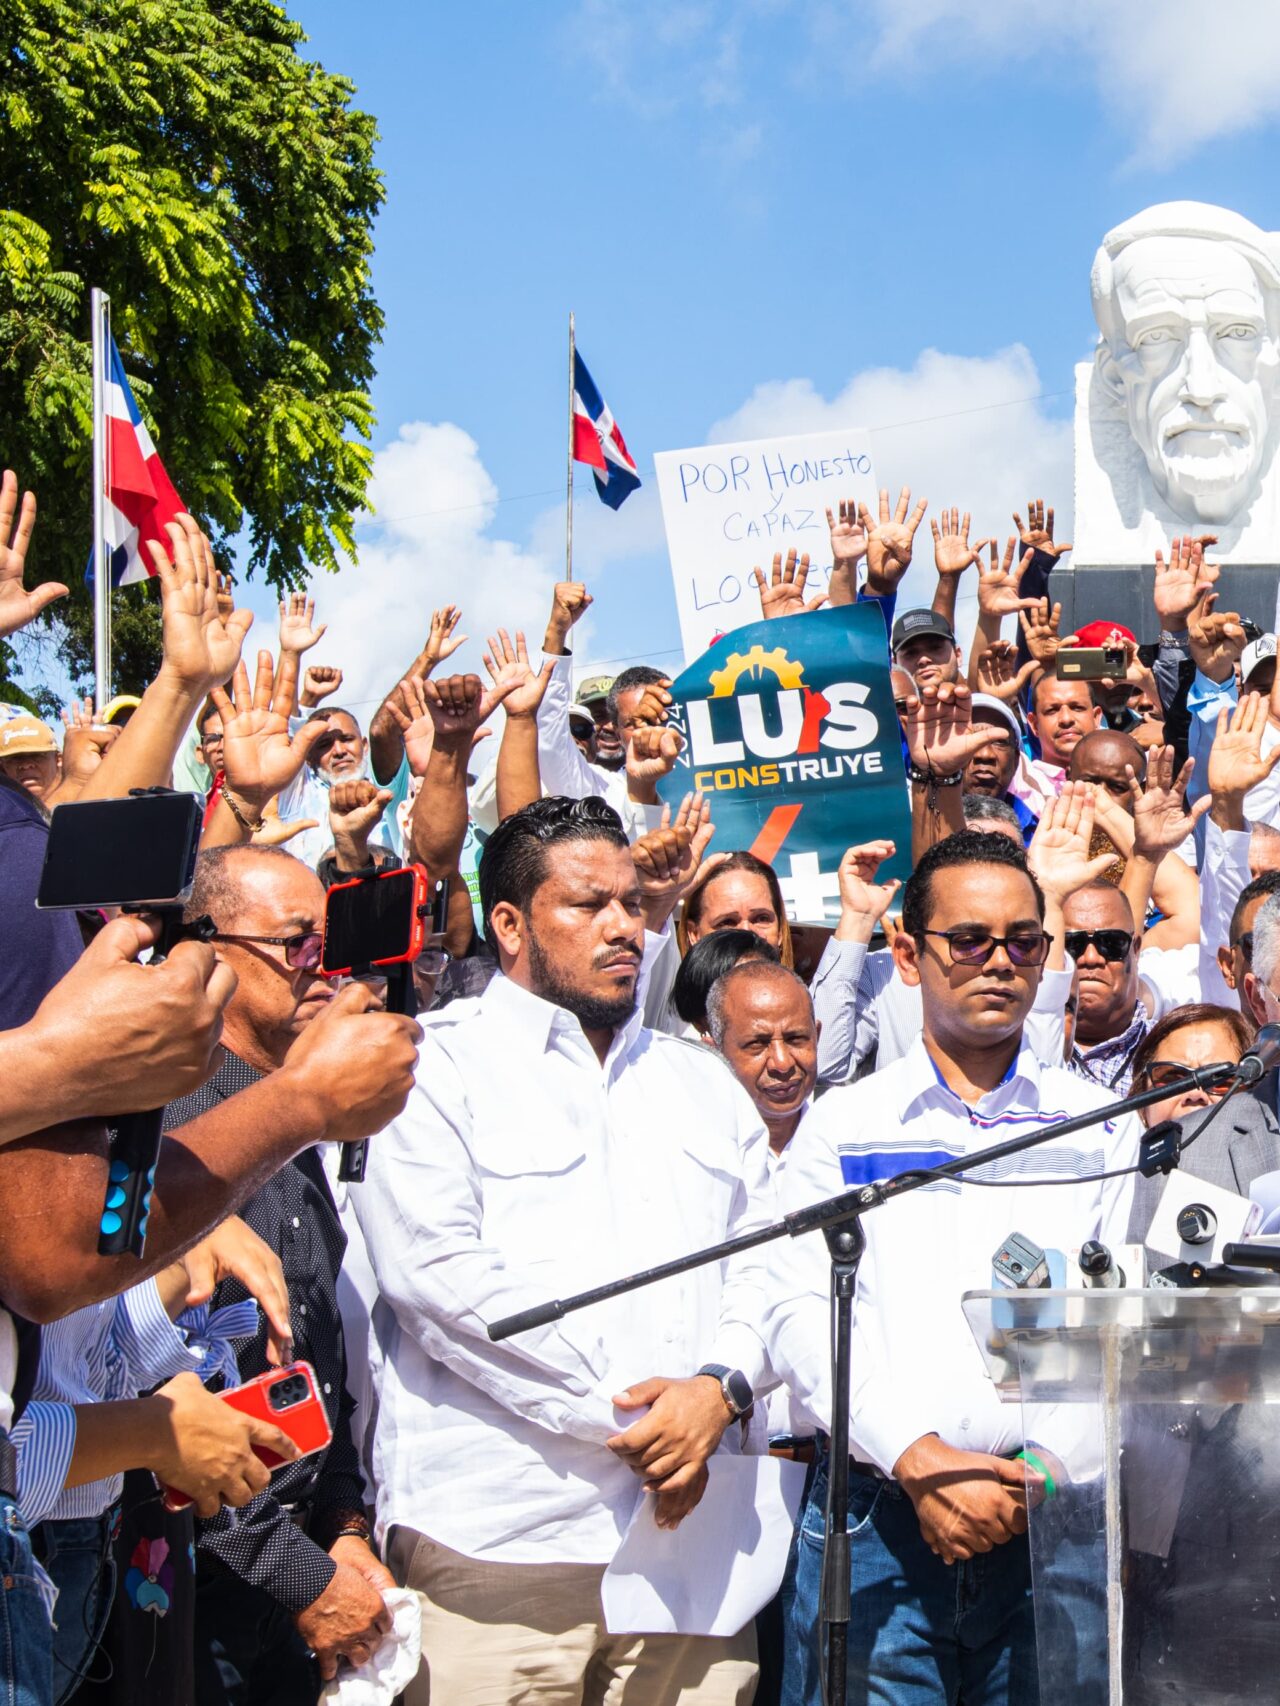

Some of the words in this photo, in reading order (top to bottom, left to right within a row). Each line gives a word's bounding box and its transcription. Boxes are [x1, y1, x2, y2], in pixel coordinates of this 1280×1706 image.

[679, 456, 751, 503] POR
[723, 508, 822, 542] CAPAZ
[694, 751, 883, 792] CONSTRUYE
